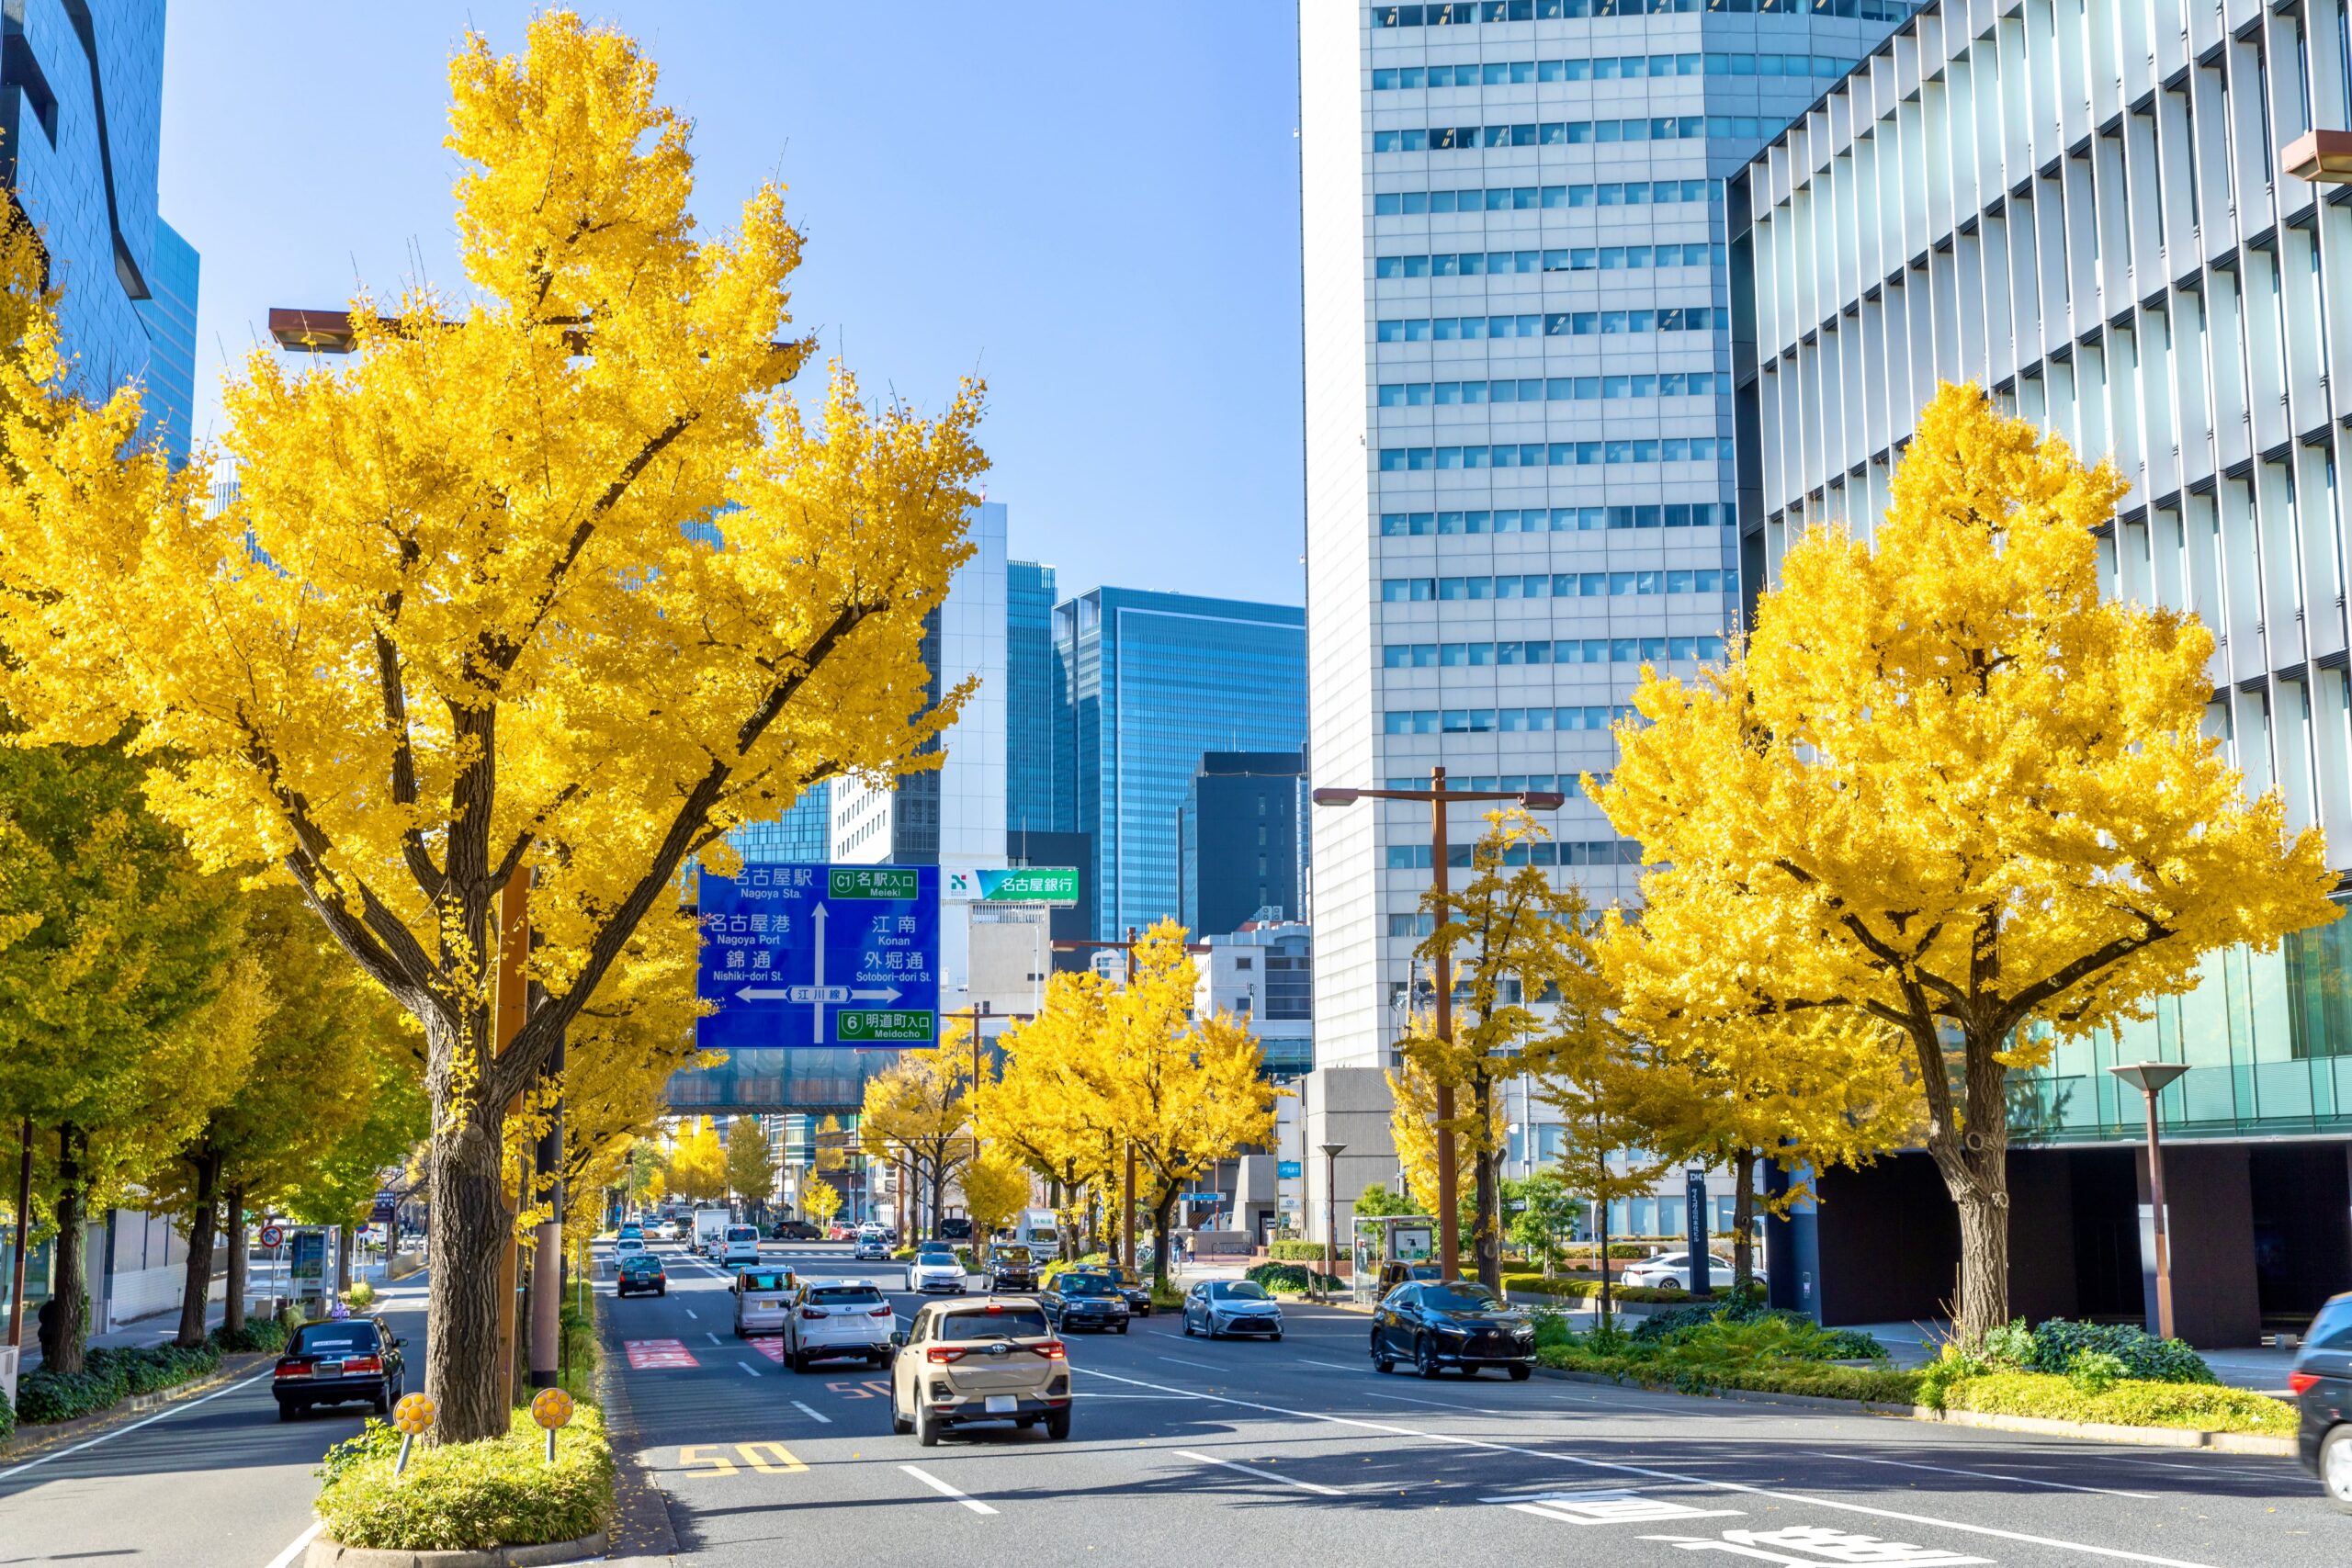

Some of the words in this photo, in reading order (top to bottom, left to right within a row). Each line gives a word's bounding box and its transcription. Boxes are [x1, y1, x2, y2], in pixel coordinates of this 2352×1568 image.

[733, 868, 813, 886] 名古屋駅
[836, 874, 851, 887] C1
[857, 872, 914, 887] 名駅入口
[1001, 878, 1073, 892] 名古屋銀行
[741, 888, 779, 899] Nagoya
[783, 888, 802, 898] Sta.
[870, 888, 901, 897] Meieki
[708, 914, 790, 932] 名古屋港
[872, 916, 916, 933] 江南
[717, 935, 756, 946] Nagoya
[759, 935, 780, 944] Port
[878, 937, 910, 945] Konan
[726, 951, 771, 969] 錦通
[865, 952, 923, 970] 外堀通
[713, 971, 768, 981] Nishiki-dori
[771, 971, 784, 981] St.
[856, 972, 917, 982] Sotobori-dori
[920, 972, 932, 982] St.
[797, 988, 841, 1000] 江川線
[847, 1016, 857, 1030] 6
[865, 1014, 930, 1029] 明道町入口
[875, 1030, 921, 1038] Meidocho
[679, 1441, 810, 1478] 50
